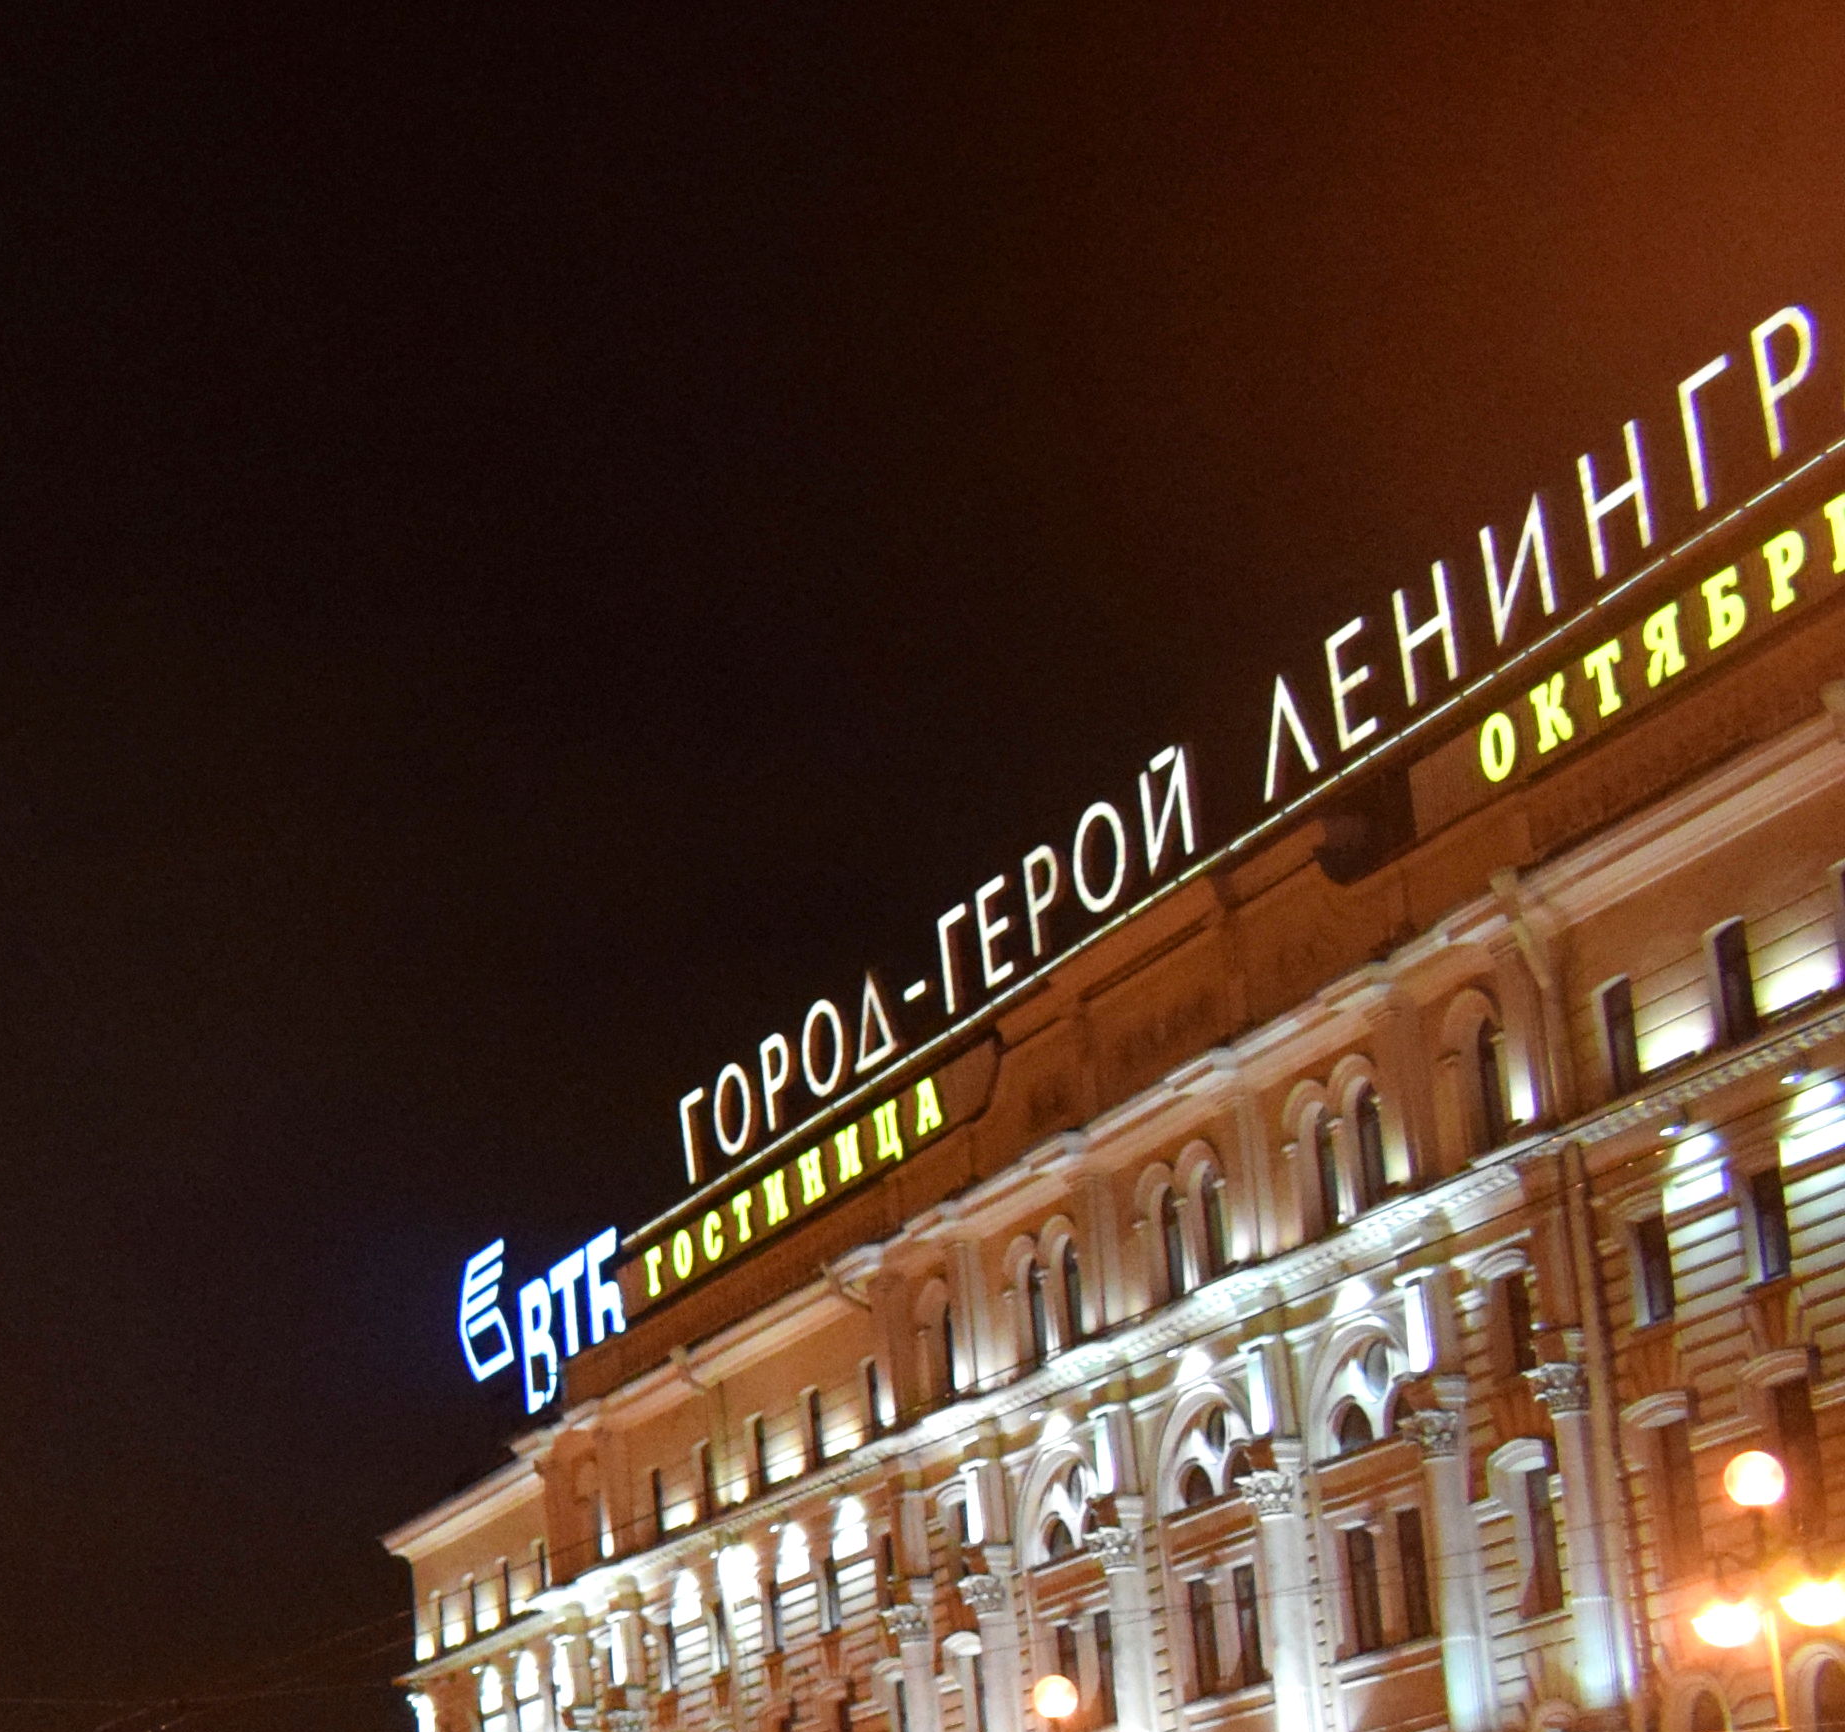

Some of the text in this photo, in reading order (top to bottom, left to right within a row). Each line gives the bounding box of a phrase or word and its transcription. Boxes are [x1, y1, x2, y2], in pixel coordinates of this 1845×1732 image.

[677, 303, 1845, 1185] ГОРОД-ГЕРОЙ ЛЕНИНГР
[644, 1076, 944, 1298] ГОСТИНИЦА
[519, 1225, 627, 1415] ВТБ
